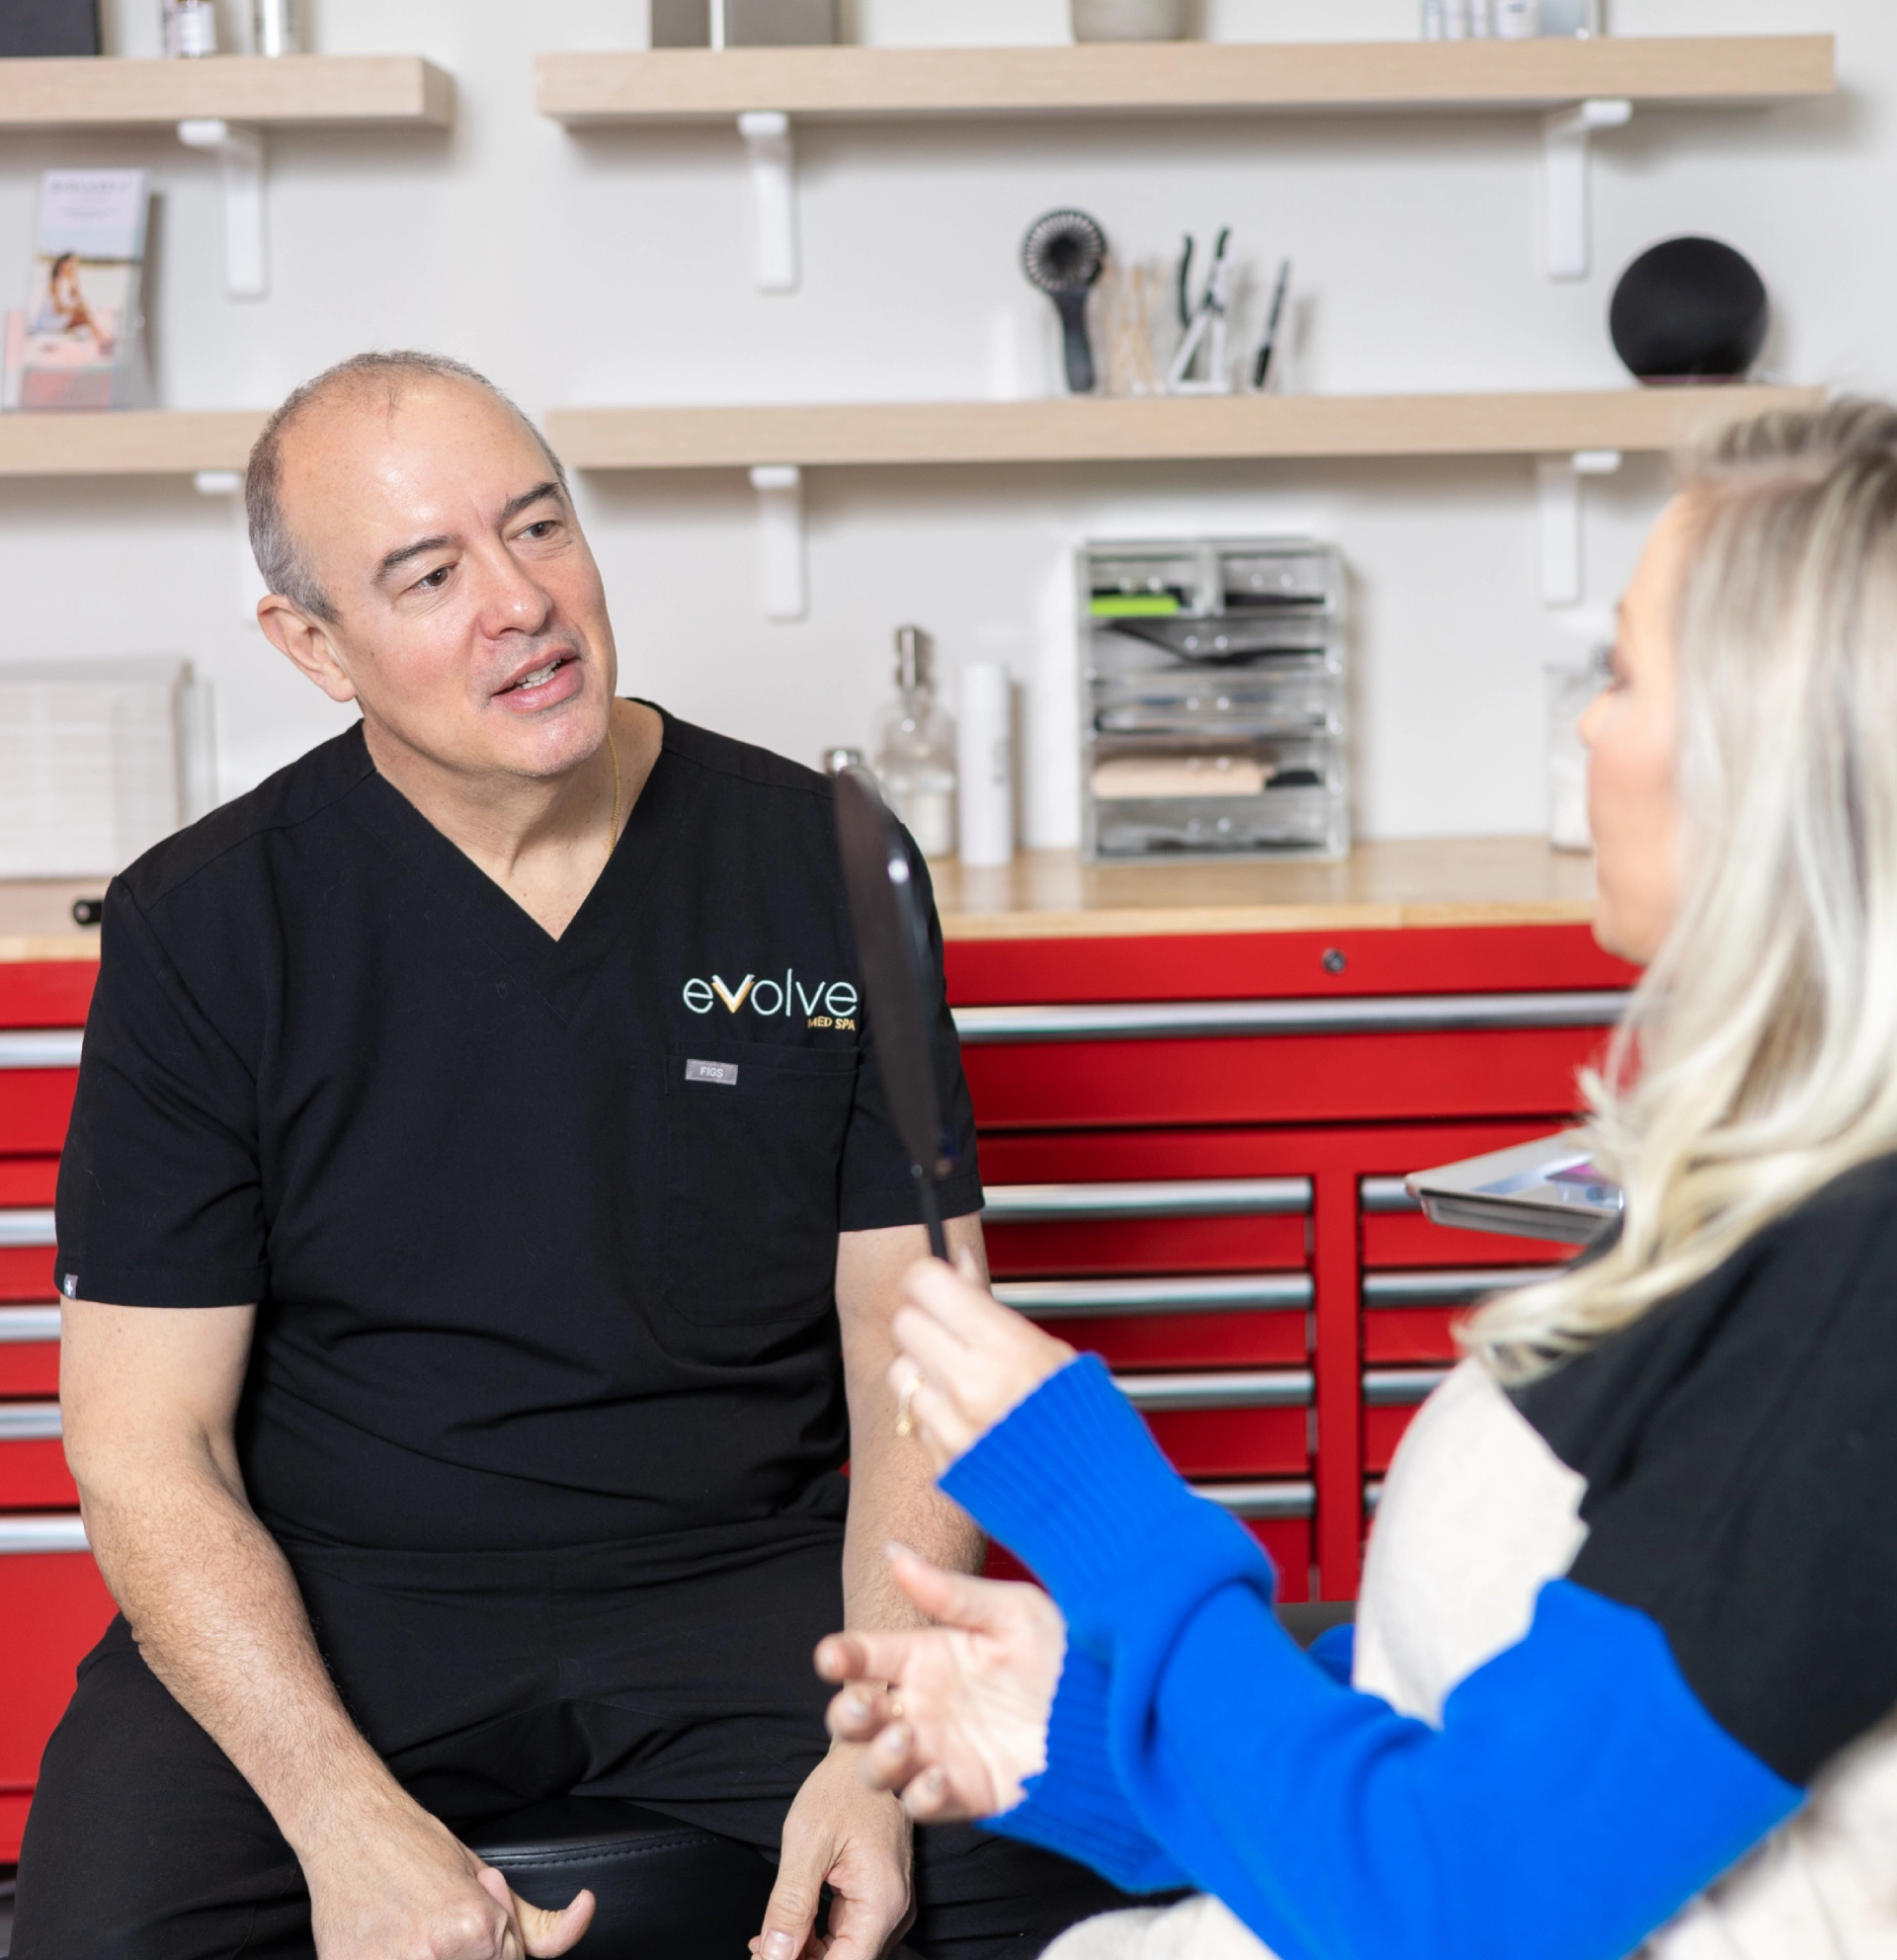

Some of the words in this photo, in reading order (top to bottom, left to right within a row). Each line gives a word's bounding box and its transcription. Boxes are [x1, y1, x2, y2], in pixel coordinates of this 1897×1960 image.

[807, 1016, 833, 1028] MED
[835, 1018, 856, 1031] SPA
[700, 1066, 724, 1078] FIGS
